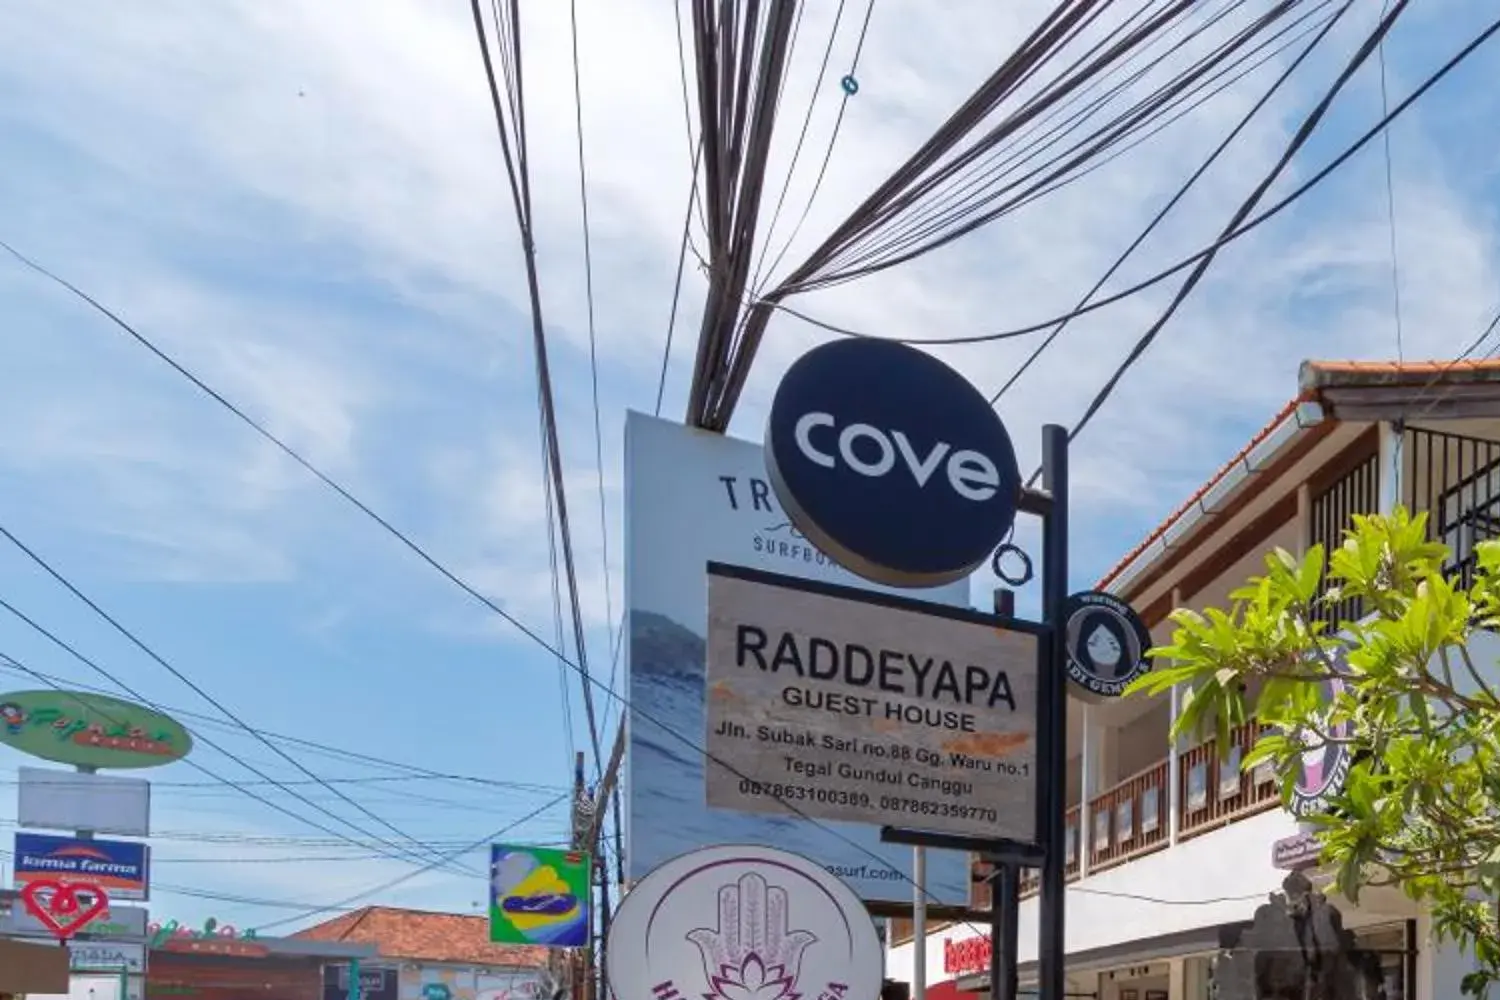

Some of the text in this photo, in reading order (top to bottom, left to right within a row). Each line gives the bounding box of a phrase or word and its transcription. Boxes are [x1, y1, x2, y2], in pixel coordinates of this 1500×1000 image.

[719, 475, 773, 513] TR
[736, 624, 1016, 711] RADDEYAPA
[782, 686, 976, 732] GUEST HOUSE
[714, 721, 1029, 776] Jln. Subak Sari no.88 Gg. Waru no.1
[784, 755, 973, 796] Tegal Gundul Canggu
[80, 859, 137, 874] farma
